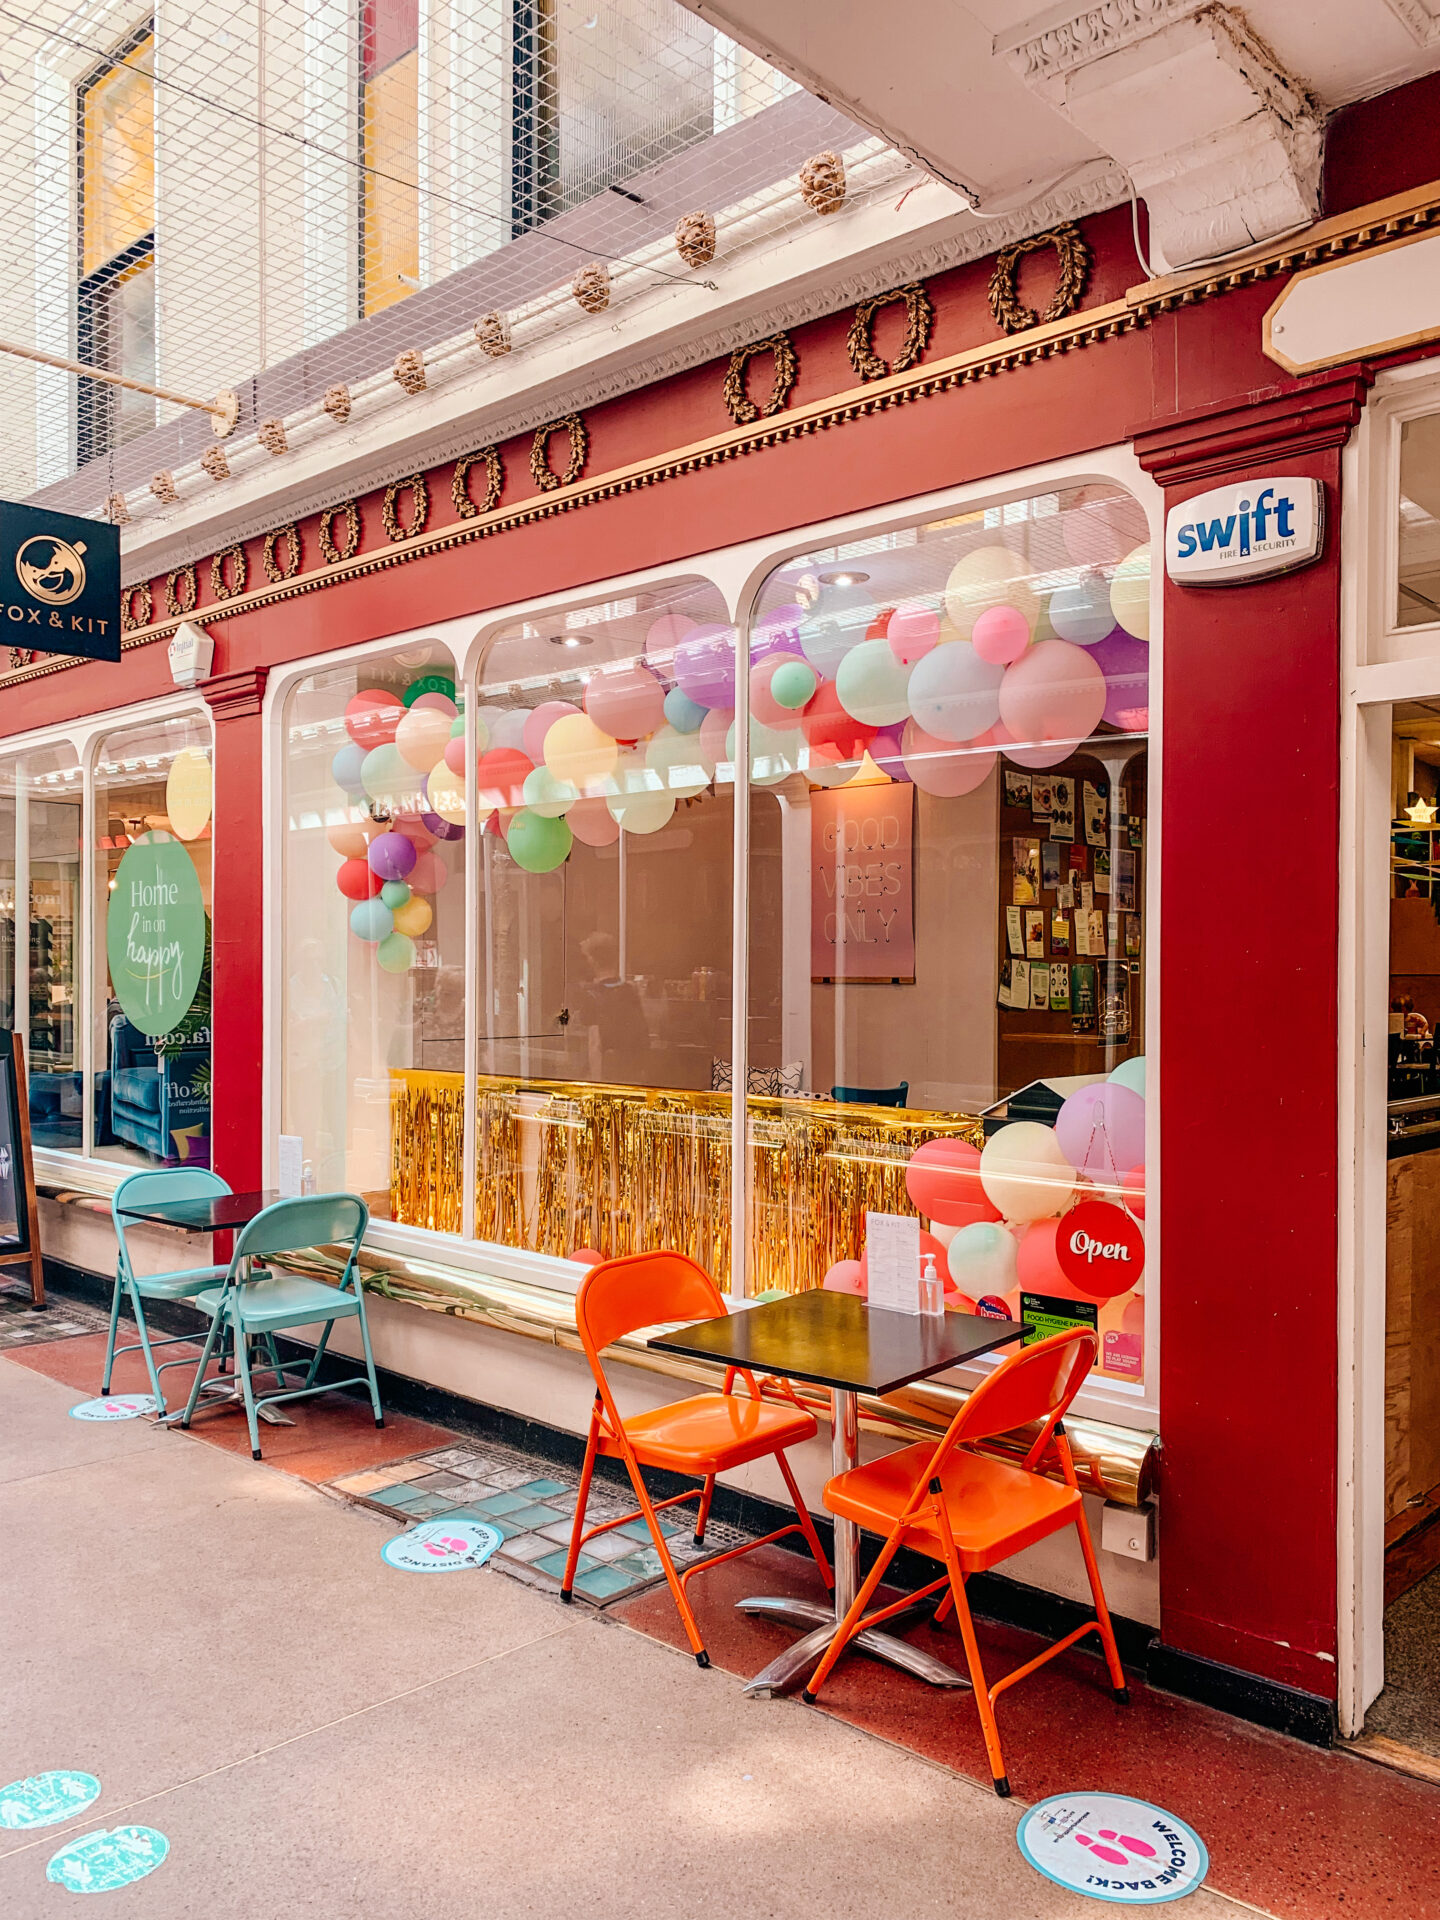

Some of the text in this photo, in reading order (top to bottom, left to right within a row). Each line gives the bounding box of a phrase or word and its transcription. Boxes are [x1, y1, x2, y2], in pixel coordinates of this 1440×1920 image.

[1177, 487, 1296, 558] swift
[1219, 549, 1238, 560] FIRE
[1252, 537, 1297, 553] SECURITY
[48, 611, 64, 629] &
[71, 615, 109, 636] KIT
[822, 815, 900, 853] GOOD
[130, 880, 179, 907] Home
[819, 862, 902, 898] VIBES
[142, 916, 166, 933] in on
[823, 908, 898, 944] ONLY
[126, 911, 184, 1006] happy
[1069, 1229, 1132, 1264] Open
[1026, 1313, 1044, 1321] FOOD
[1045, 1316, 1069, 1327] HYGIENE
[1085, 1820, 1187, 1891] WELCOME BACK!
